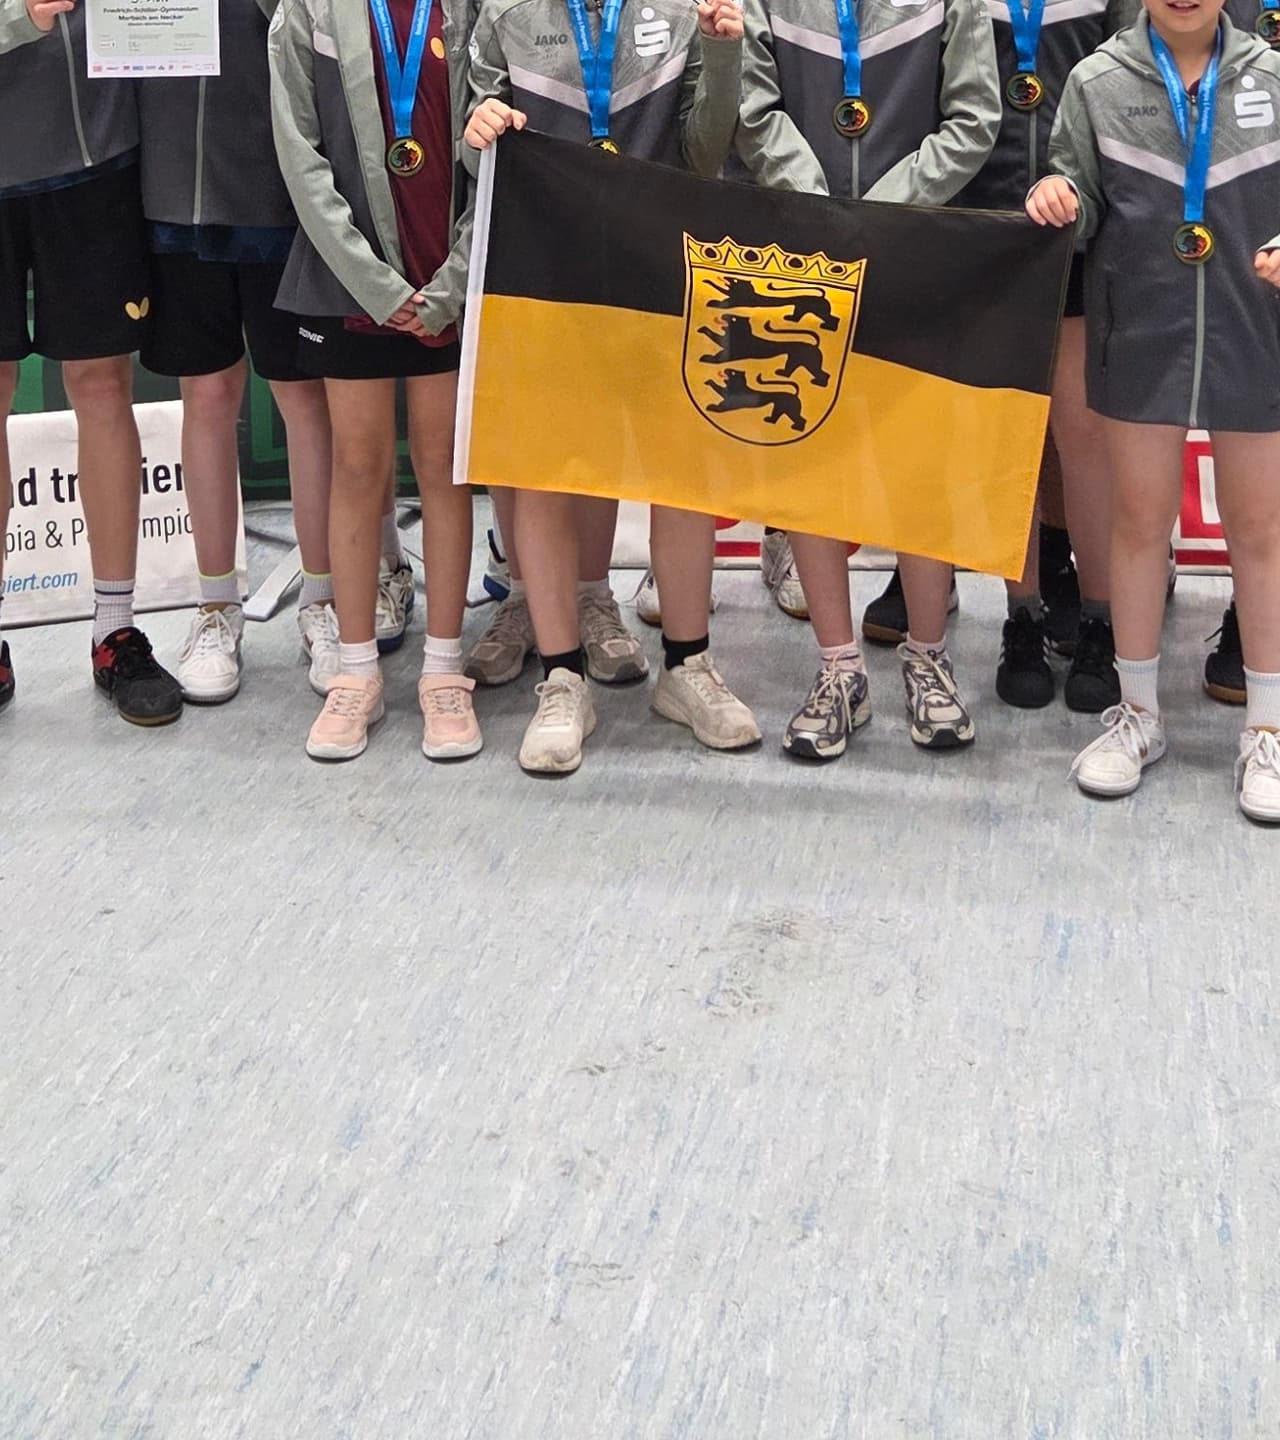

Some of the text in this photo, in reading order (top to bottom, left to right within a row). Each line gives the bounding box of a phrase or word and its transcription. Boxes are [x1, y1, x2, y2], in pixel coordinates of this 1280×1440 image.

[534, 33, 568, 46] JAKO
[1127, 105, 1158, 117] JAKO
[45, 520, 63, 549] &
